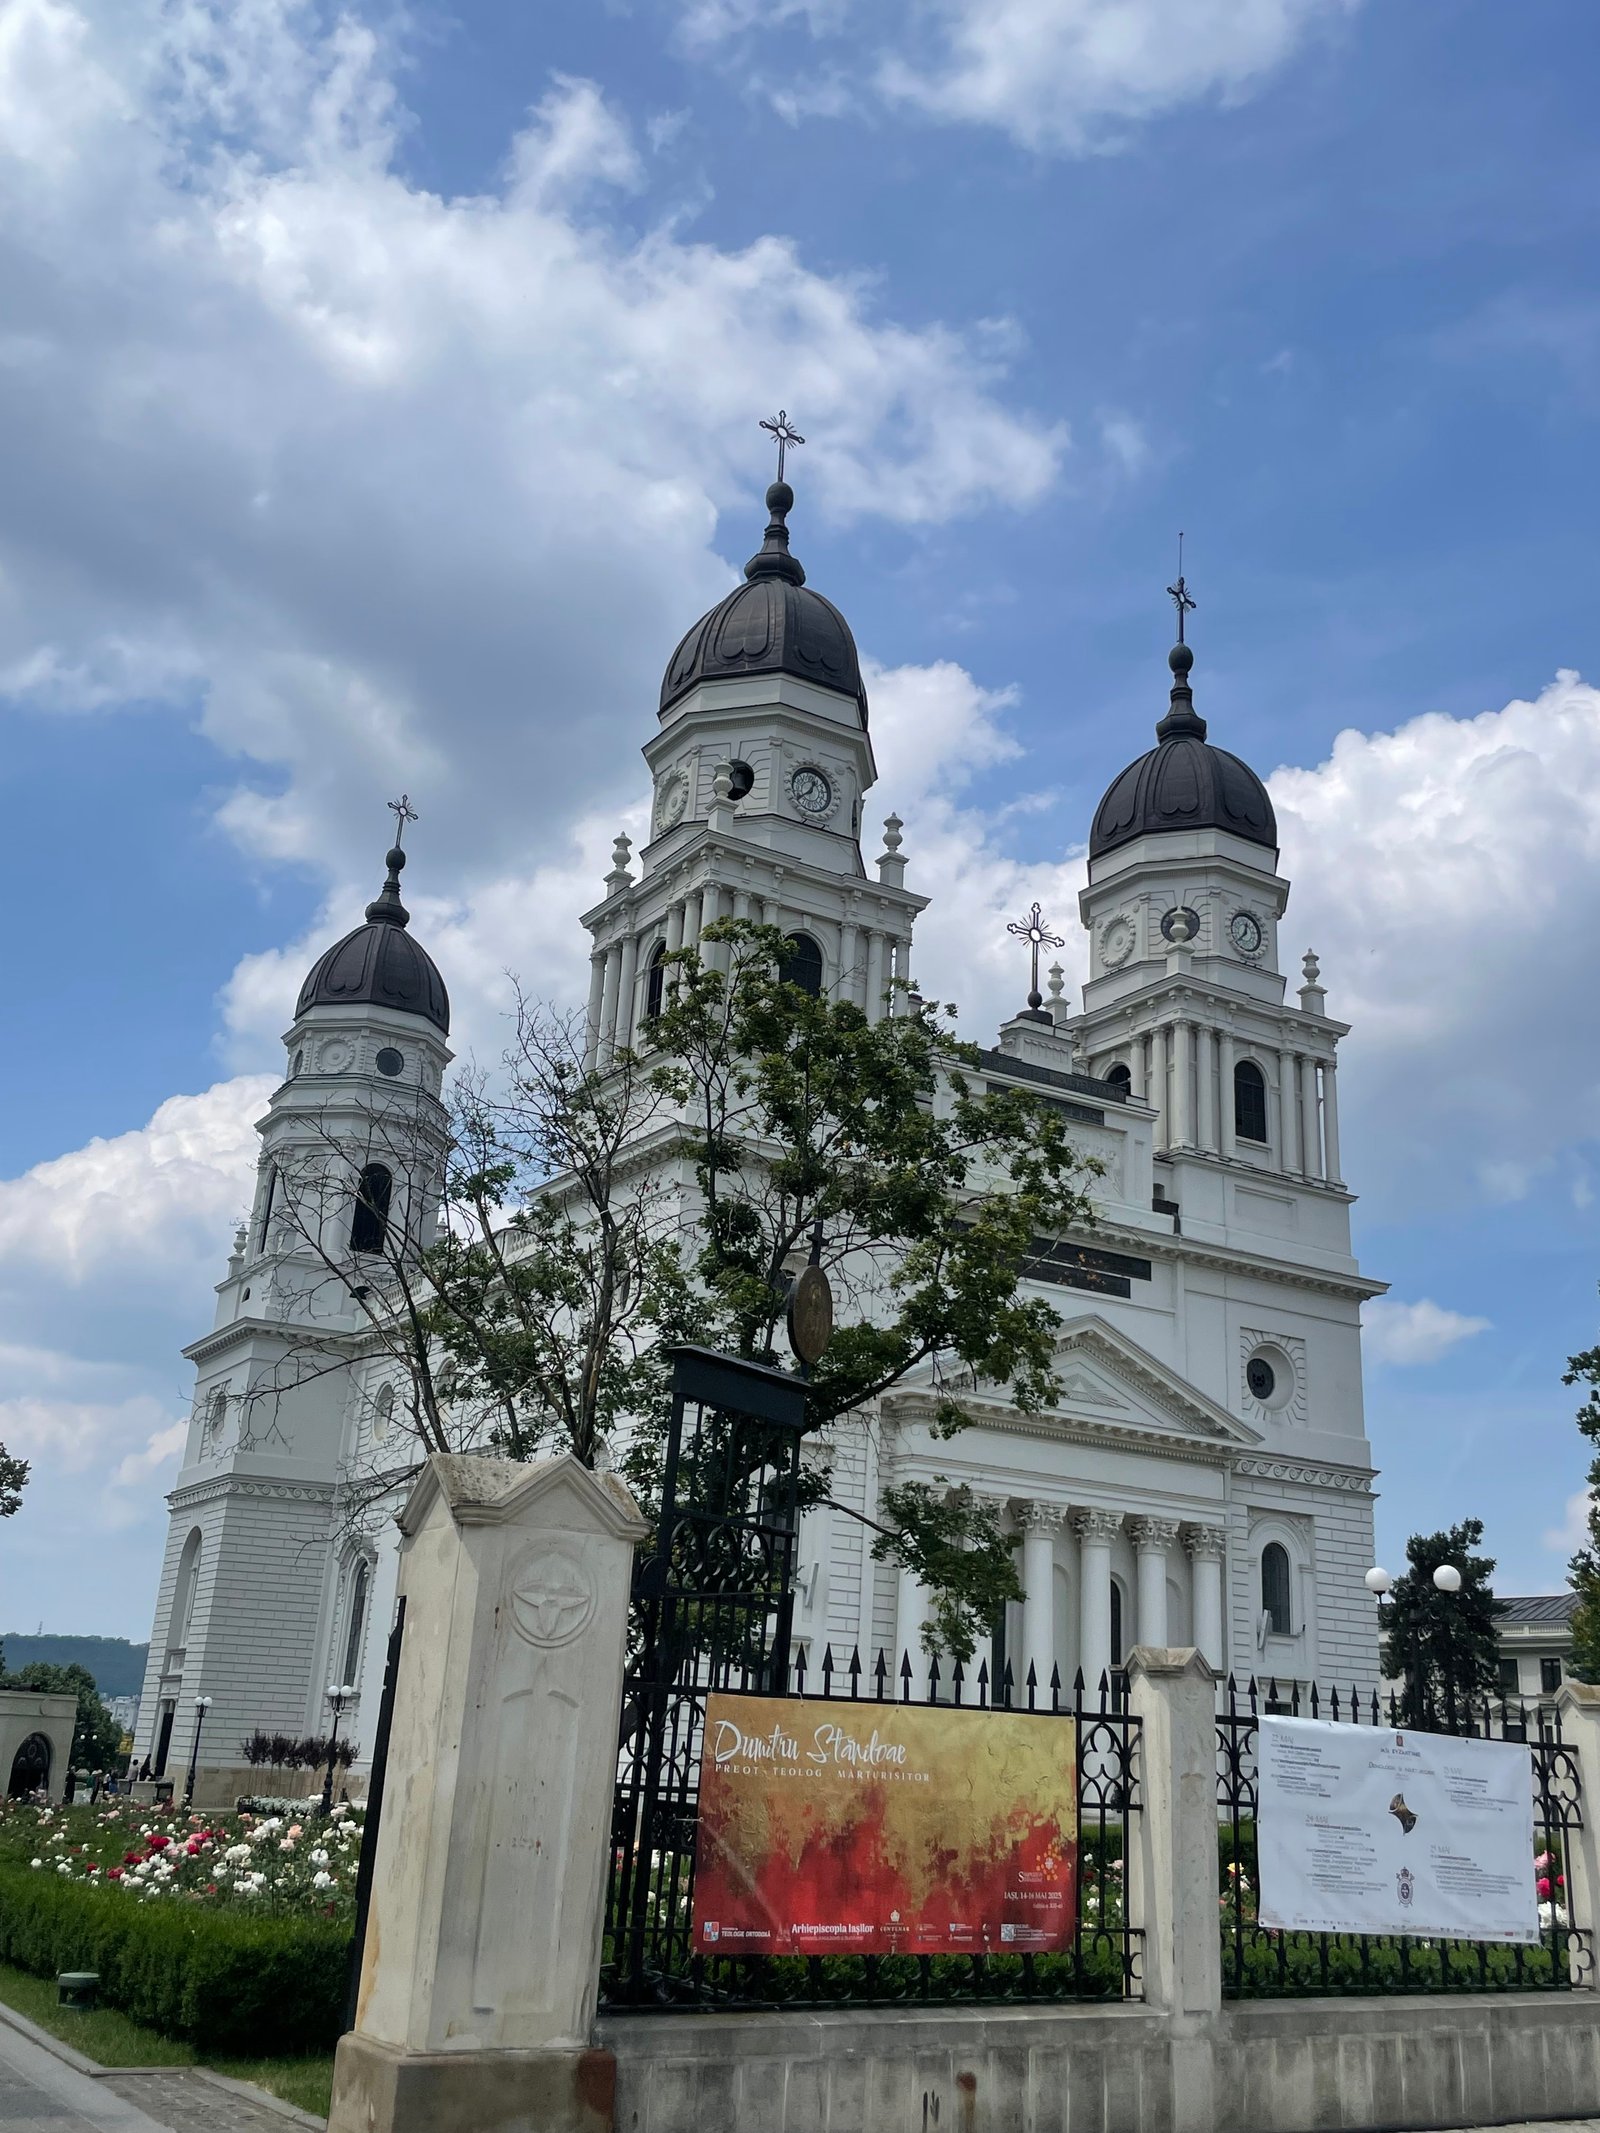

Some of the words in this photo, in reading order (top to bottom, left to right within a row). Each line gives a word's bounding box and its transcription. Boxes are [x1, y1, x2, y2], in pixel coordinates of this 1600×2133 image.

[714, 1721, 801, 1763] Dumitru
[715, 1764, 760, 1775] PREOT
[773, 1767, 822, 1778] TEOLOG
[791, 1923, 847, 1935] Arhiepiscopia
